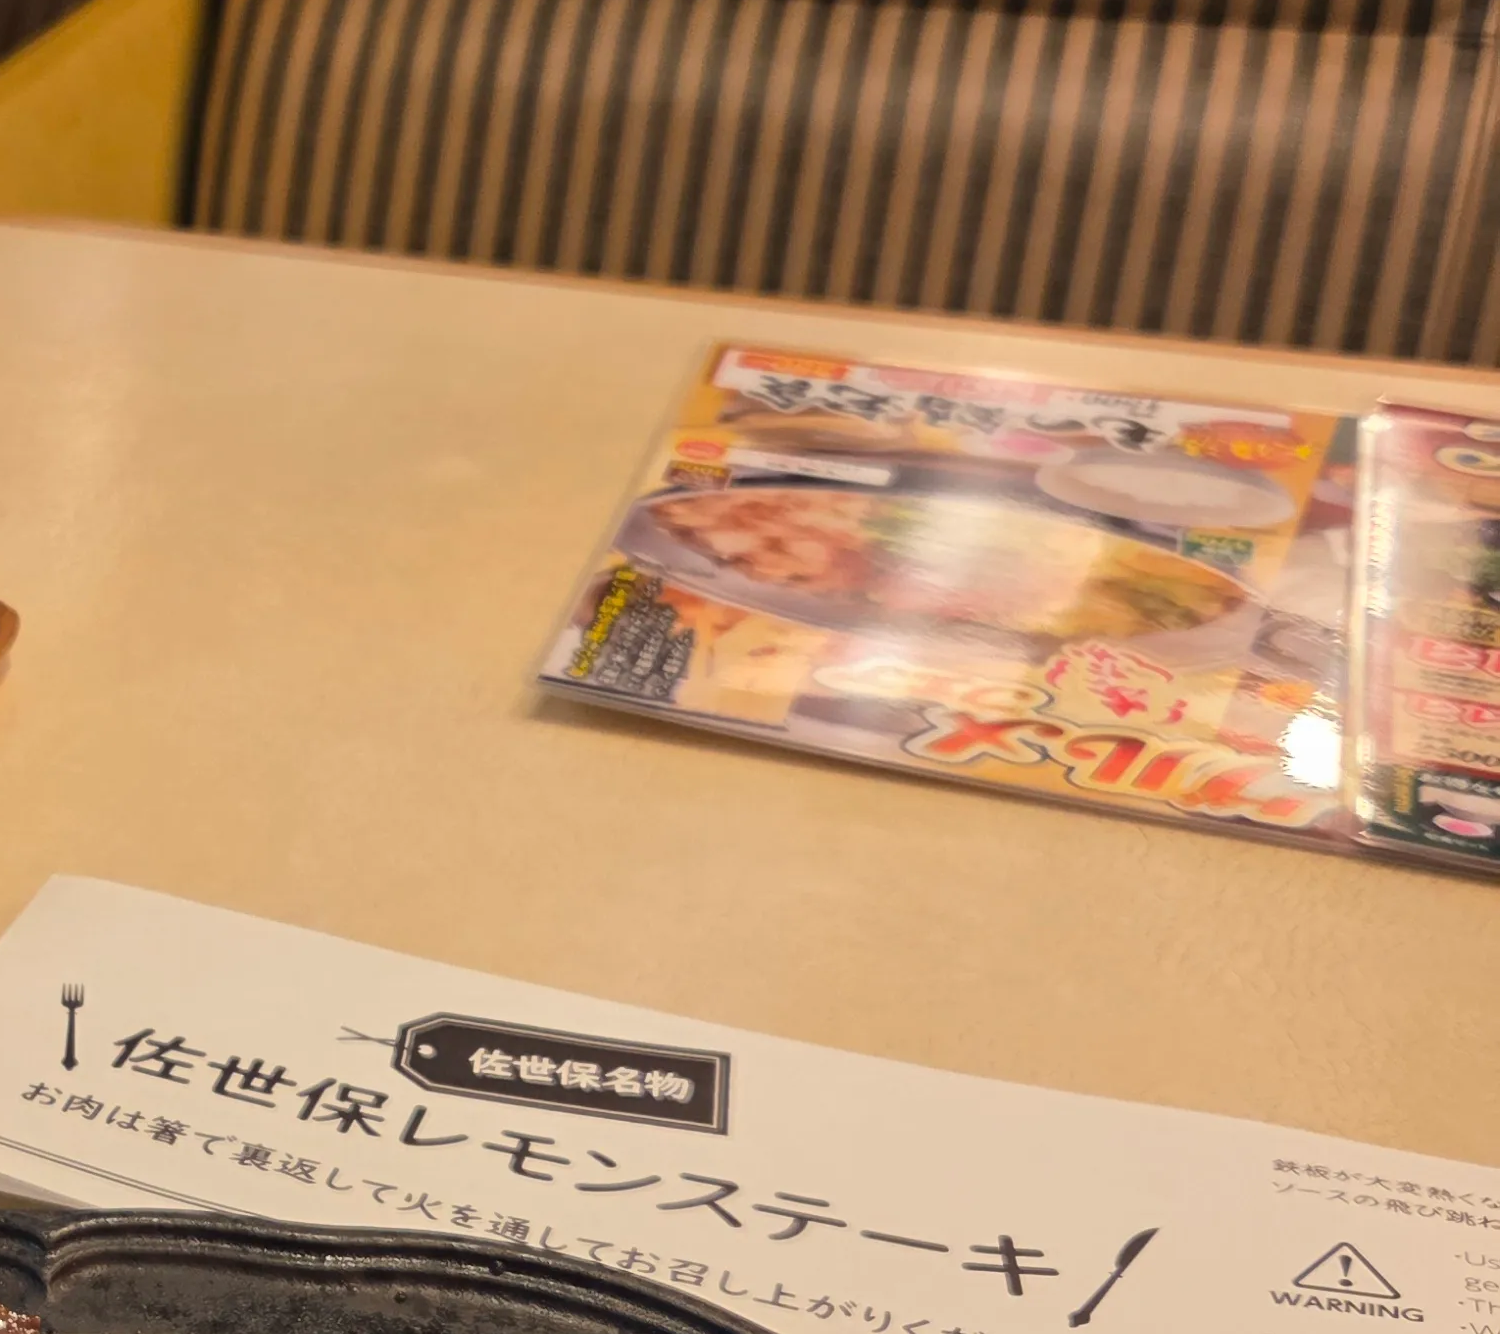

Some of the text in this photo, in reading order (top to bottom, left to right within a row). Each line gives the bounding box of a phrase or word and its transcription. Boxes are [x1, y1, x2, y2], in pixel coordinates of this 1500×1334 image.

[466, 1046, 695, 1105] 佐世保名物
[112, 1027, 1060, 1296] 佐世保レモンステーキ
[1268, 1289, 1425, 1323] WARNING
